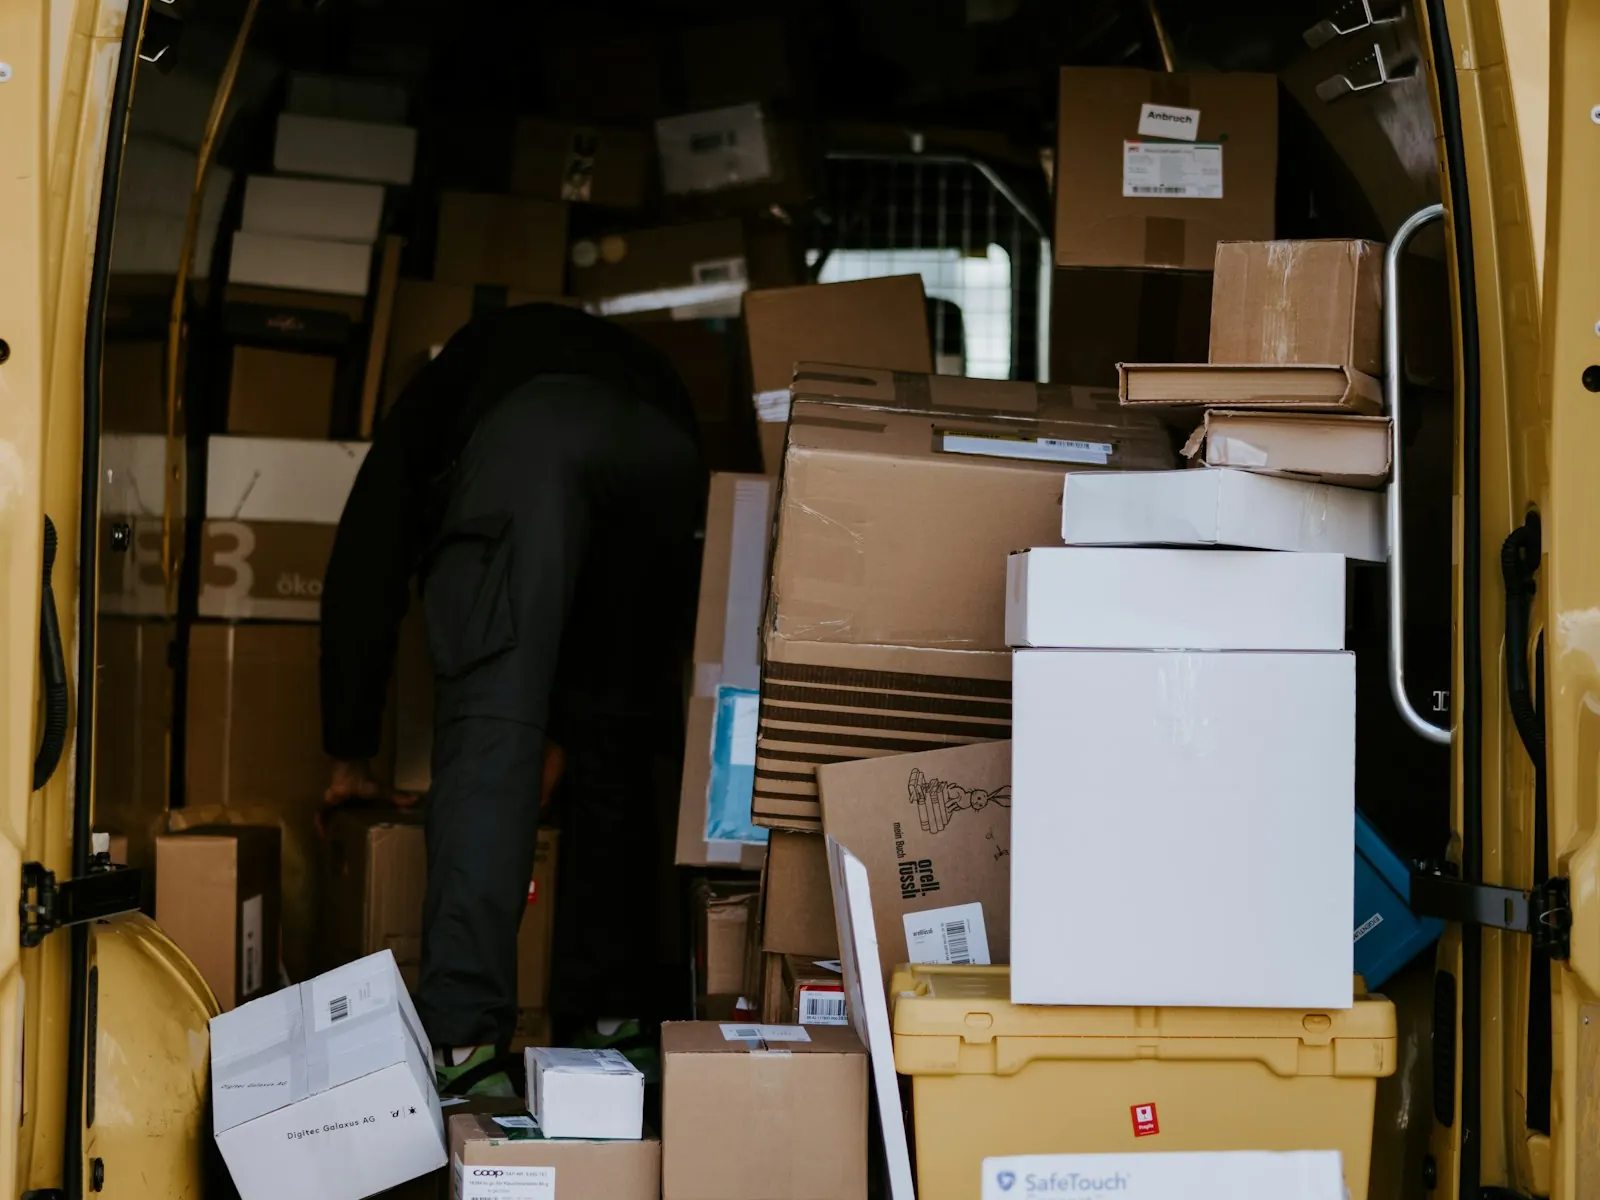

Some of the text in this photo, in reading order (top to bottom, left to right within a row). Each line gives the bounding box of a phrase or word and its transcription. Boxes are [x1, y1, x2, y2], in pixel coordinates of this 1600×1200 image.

[1146, 110, 1193, 124] Anbruch
[893, 822, 907, 858] mein Buch
[286, 1115, 376, 1140] Digitec Galaxus AG
[473, 1169, 504, 1178] coop
[1024, 1171, 1128, 1192] SafeTouch
